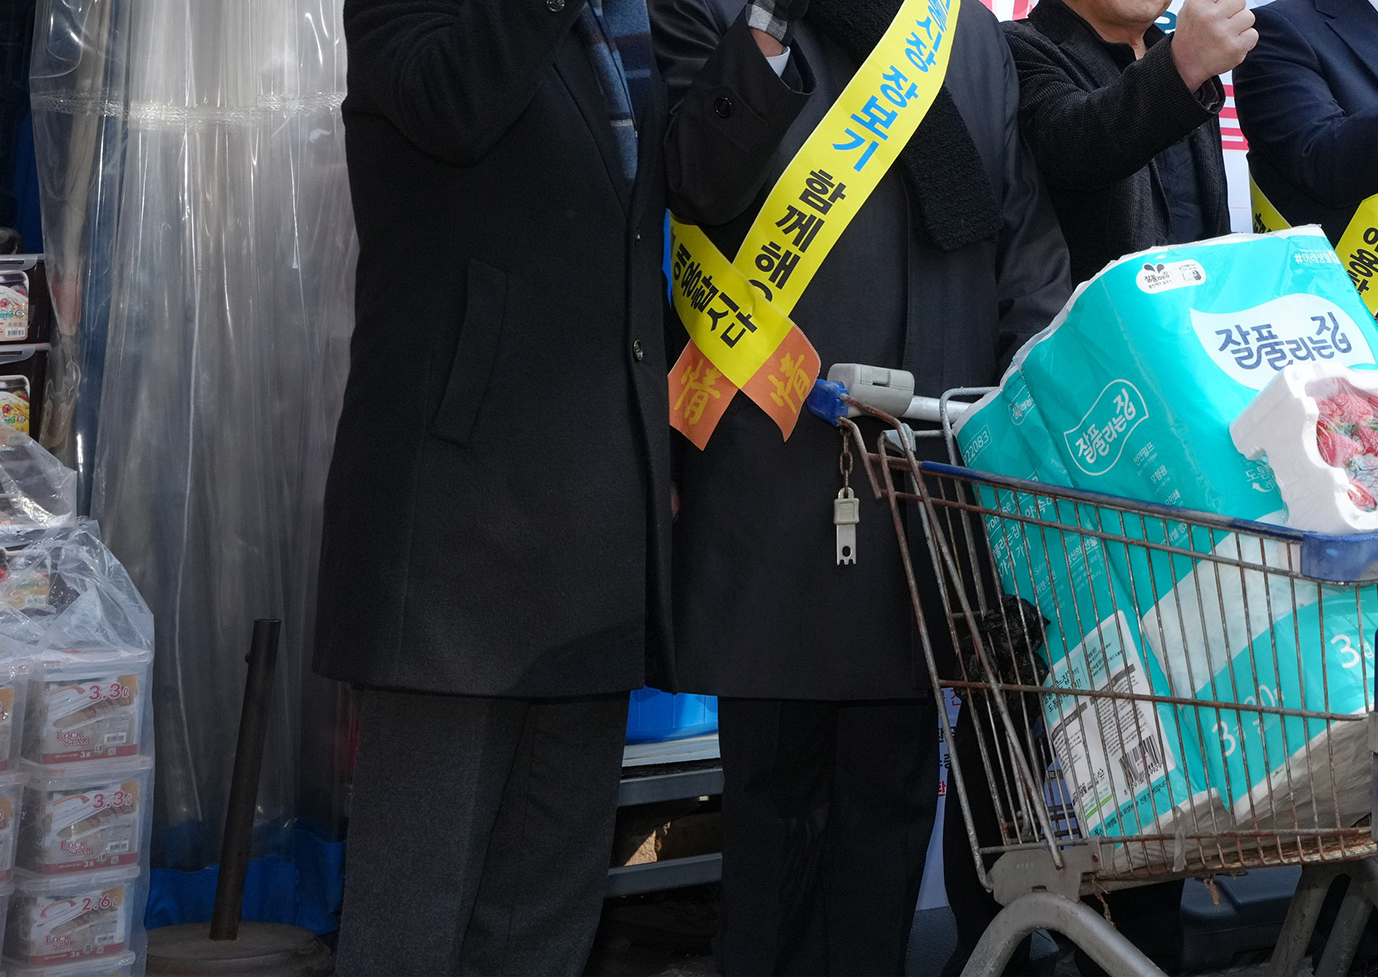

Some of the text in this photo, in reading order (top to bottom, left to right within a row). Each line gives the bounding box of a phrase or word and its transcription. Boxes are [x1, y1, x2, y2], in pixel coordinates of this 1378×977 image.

[832, 64, 920, 172] 장보기
[1215, 311, 1352, 372] 잘풀리는집
[1075, 388, 1136, 464] 잘풀리는집
